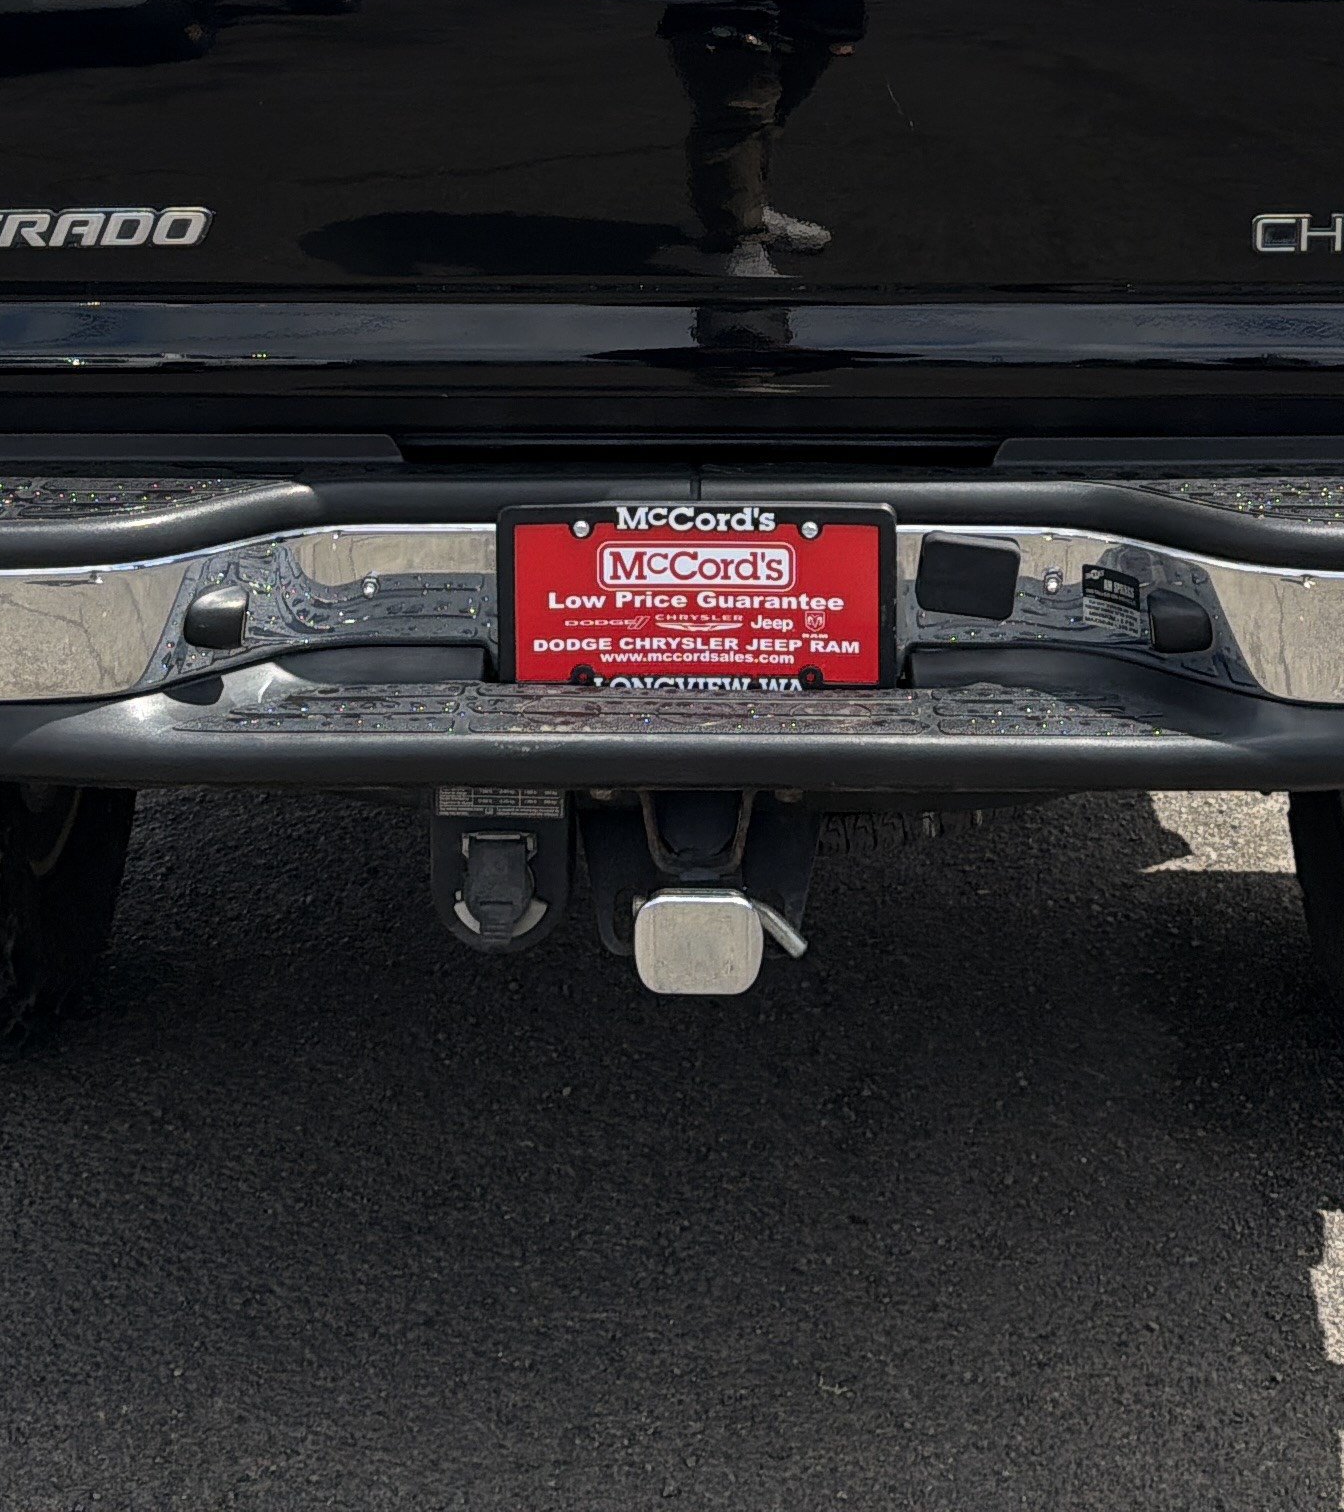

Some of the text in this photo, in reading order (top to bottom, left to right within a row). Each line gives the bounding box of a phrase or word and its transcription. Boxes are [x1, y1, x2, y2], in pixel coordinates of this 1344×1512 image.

[616, 506, 776, 532] McCord's
[609, 551, 784, 581] McCord's
[548, 591, 845, 610] Low Price Guarantee
[564, 619, 638, 627] DODGE
[750, 615, 794, 632] Jeep
[533, 637, 860, 654] DODGE CHRYSLER JEEP RAM
[600, 651, 795, 664] www.mccordsales.com
